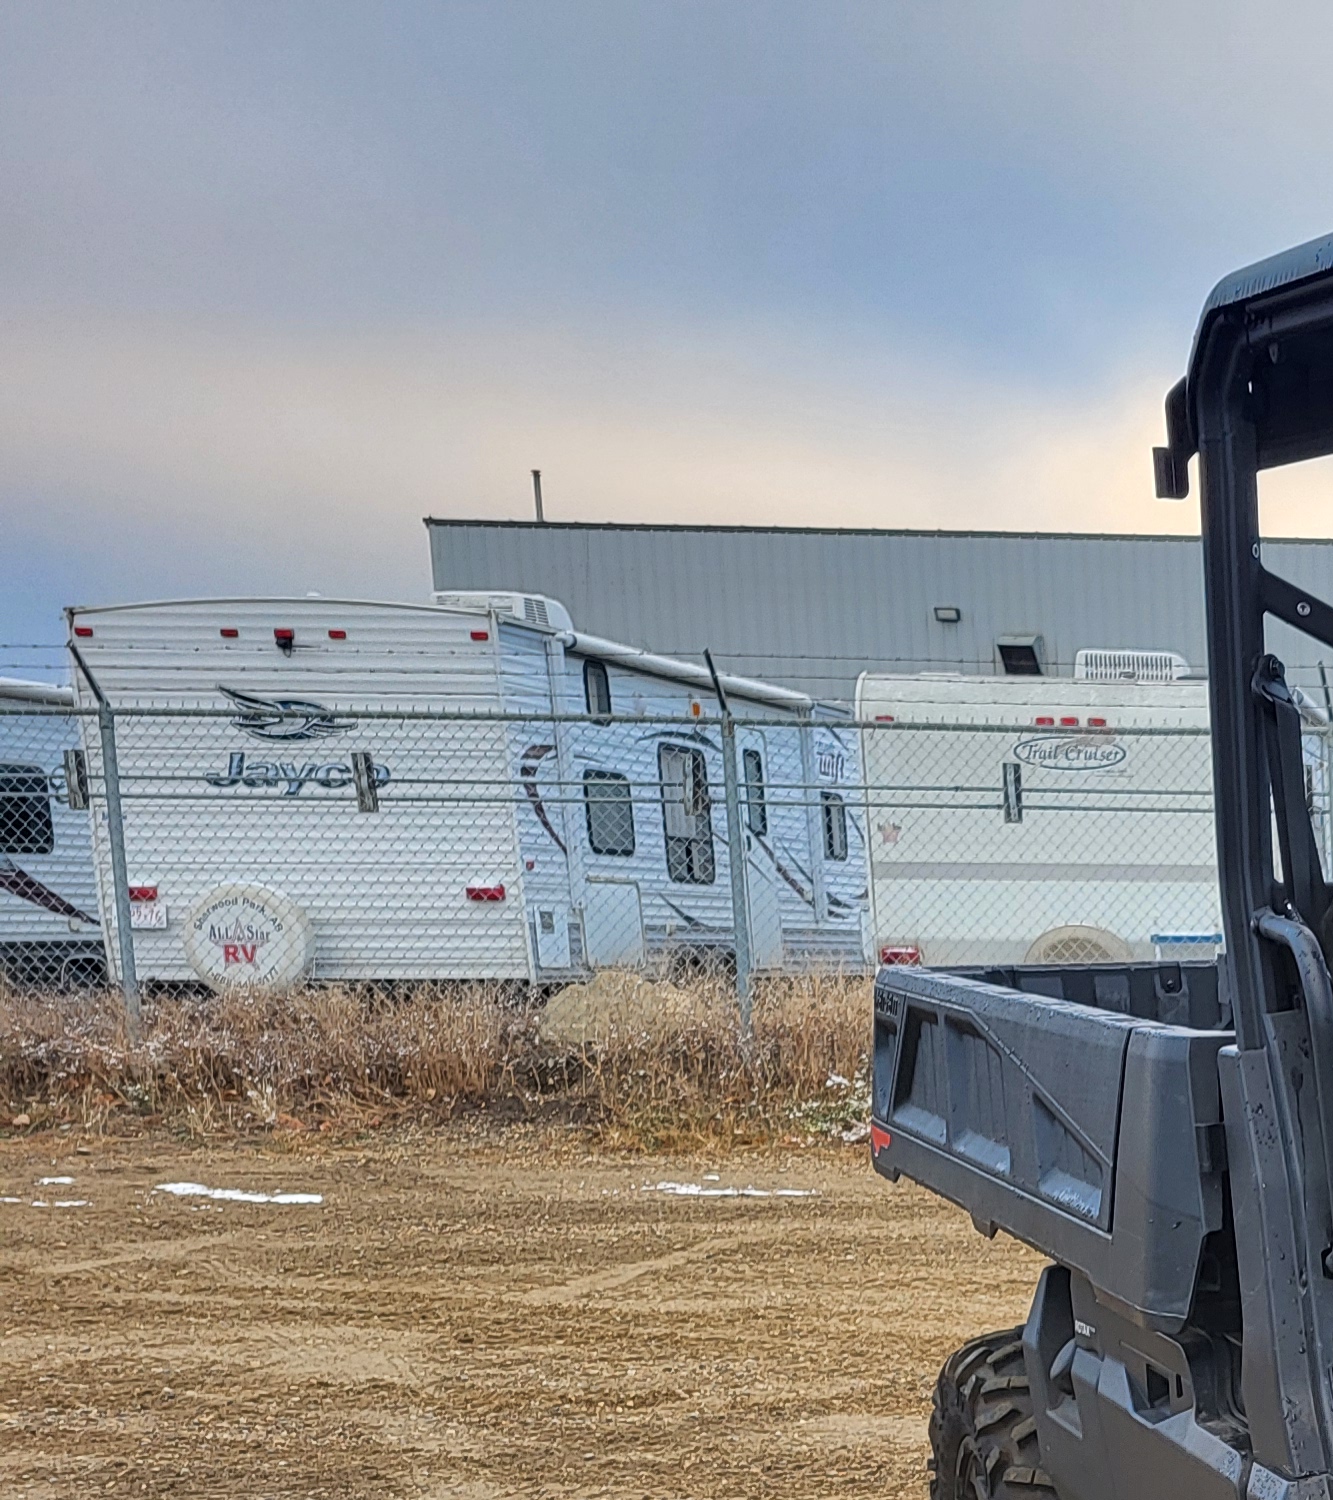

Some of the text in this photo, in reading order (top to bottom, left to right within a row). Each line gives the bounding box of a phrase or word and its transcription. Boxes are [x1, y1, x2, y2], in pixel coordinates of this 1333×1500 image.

[1022, 744, 1121, 761] Trail Cruiser
[194, 897, 238, 931] Sherwood
[224, 944, 257, 963] RV
